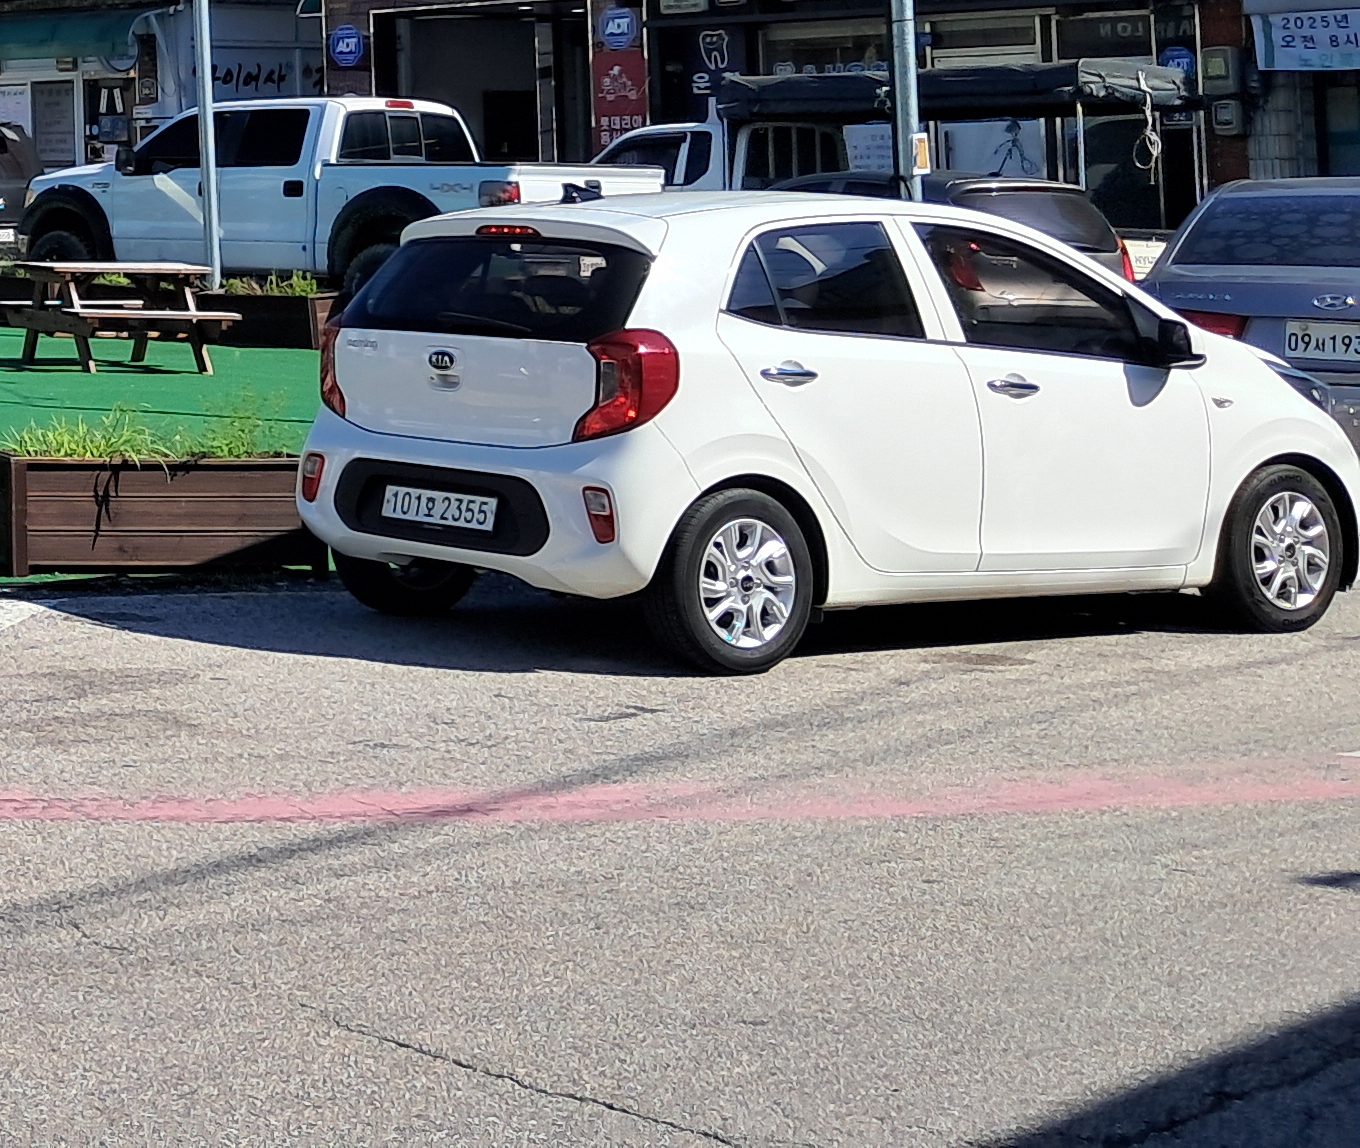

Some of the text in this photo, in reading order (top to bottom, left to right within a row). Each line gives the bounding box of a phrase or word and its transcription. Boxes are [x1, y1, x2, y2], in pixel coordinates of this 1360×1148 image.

[605, 17, 631, 35] ADT
[1281, 13, 1350, 30] 2025년
[335, 37, 358, 54] ADT
[1280, 34, 1317, 50] 오전
[430, 355, 452, 368] KIA
